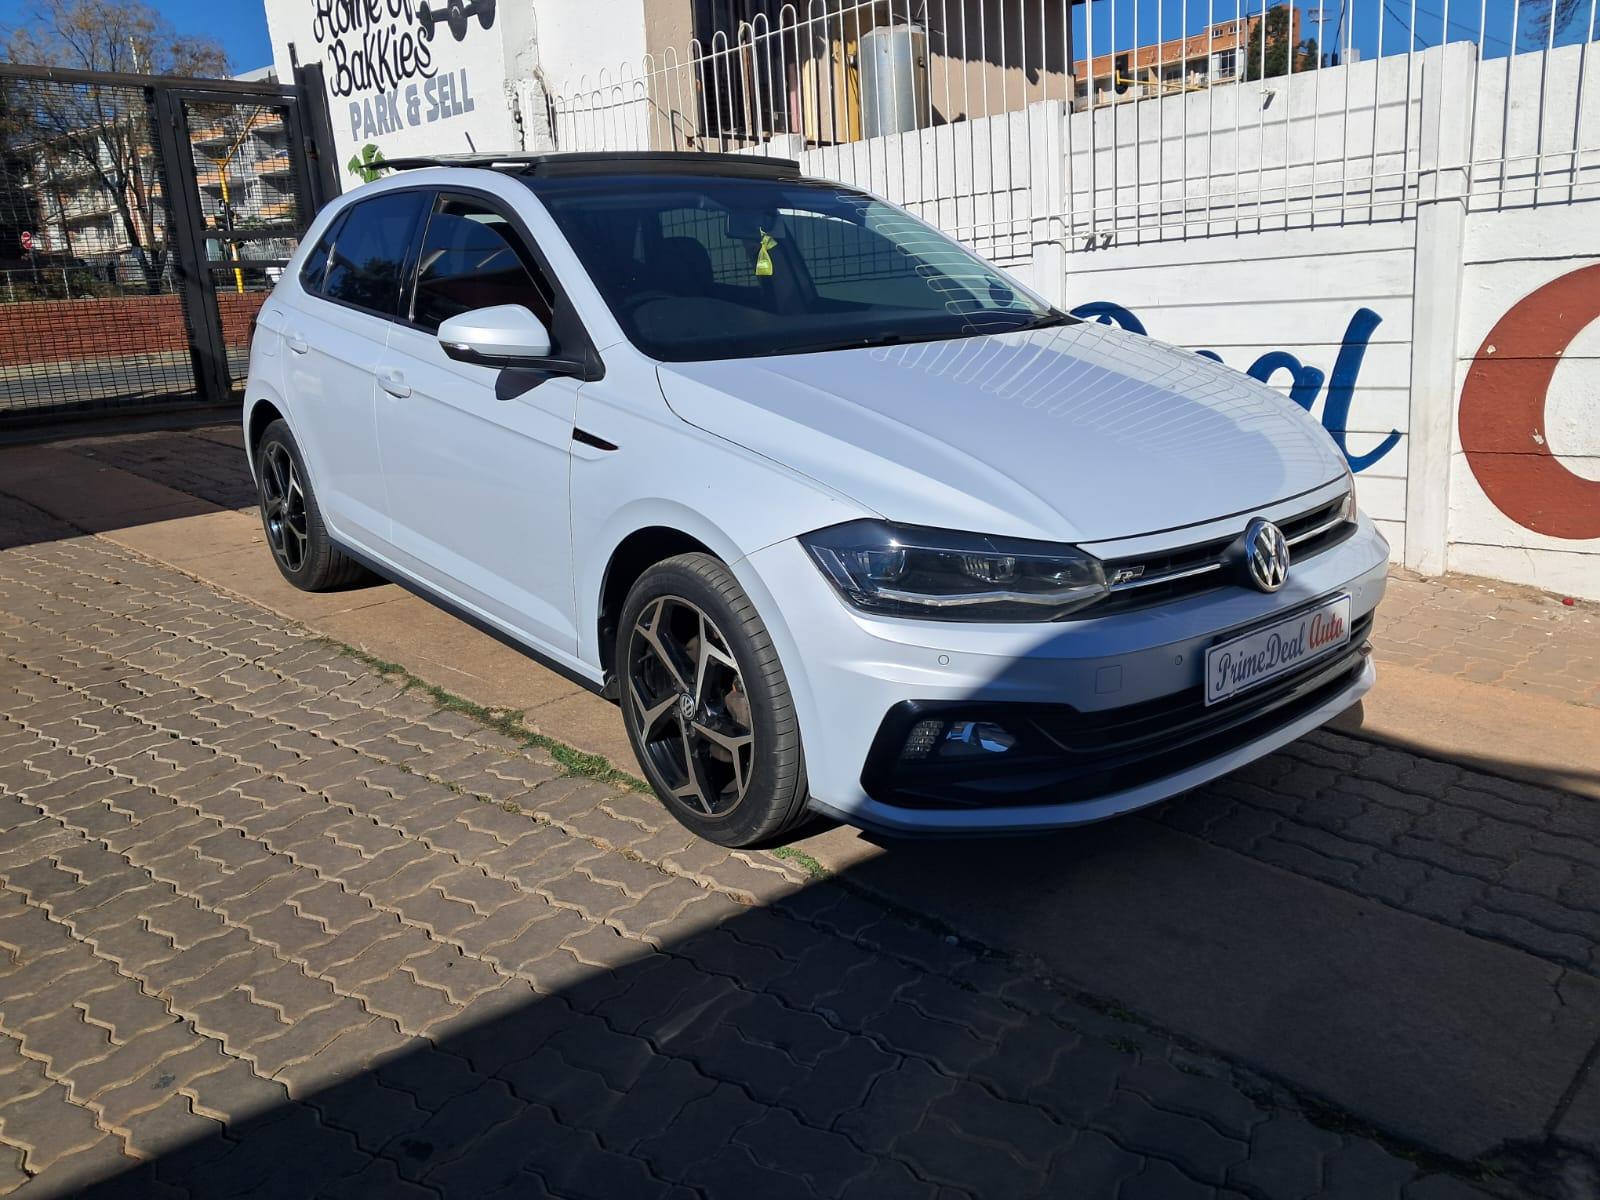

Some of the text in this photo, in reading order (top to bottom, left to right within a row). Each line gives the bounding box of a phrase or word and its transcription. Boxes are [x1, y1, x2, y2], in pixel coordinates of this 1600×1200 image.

[349, 67, 475, 142] PARK & SELL
[1309, 613, 1344, 650] Auto
